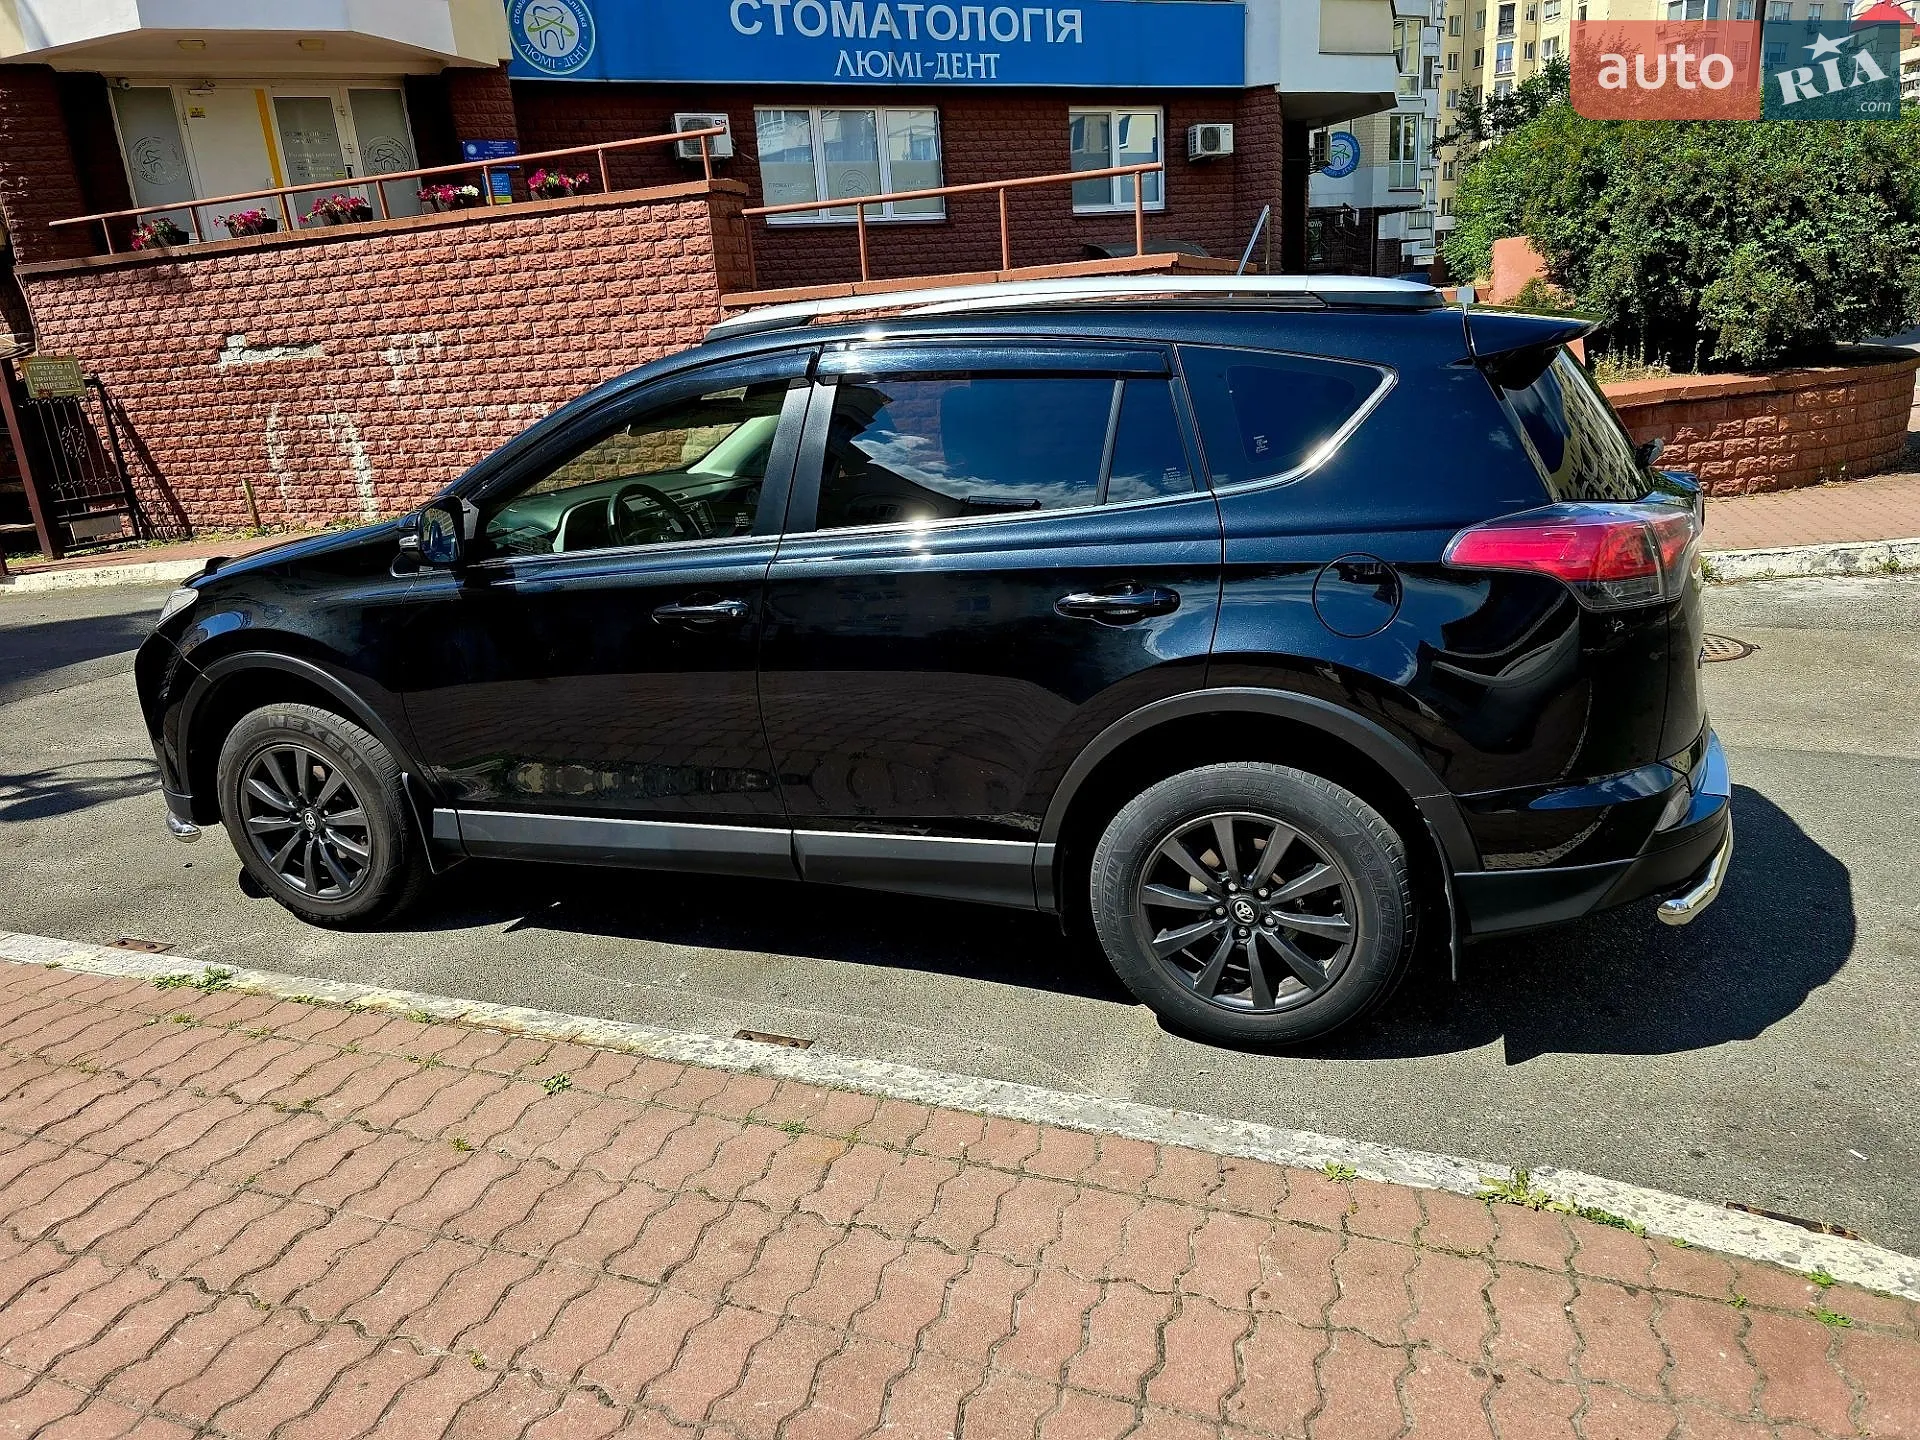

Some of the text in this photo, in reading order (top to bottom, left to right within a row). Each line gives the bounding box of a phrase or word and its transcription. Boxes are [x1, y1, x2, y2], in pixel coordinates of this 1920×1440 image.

[730, 0, 1083, 43] СТОМАТОЛОГІЯ
[834, 50, 1000, 80] ЛЮМІ-ДЕНТ
[267, 715, 363, 770] NEXEN
